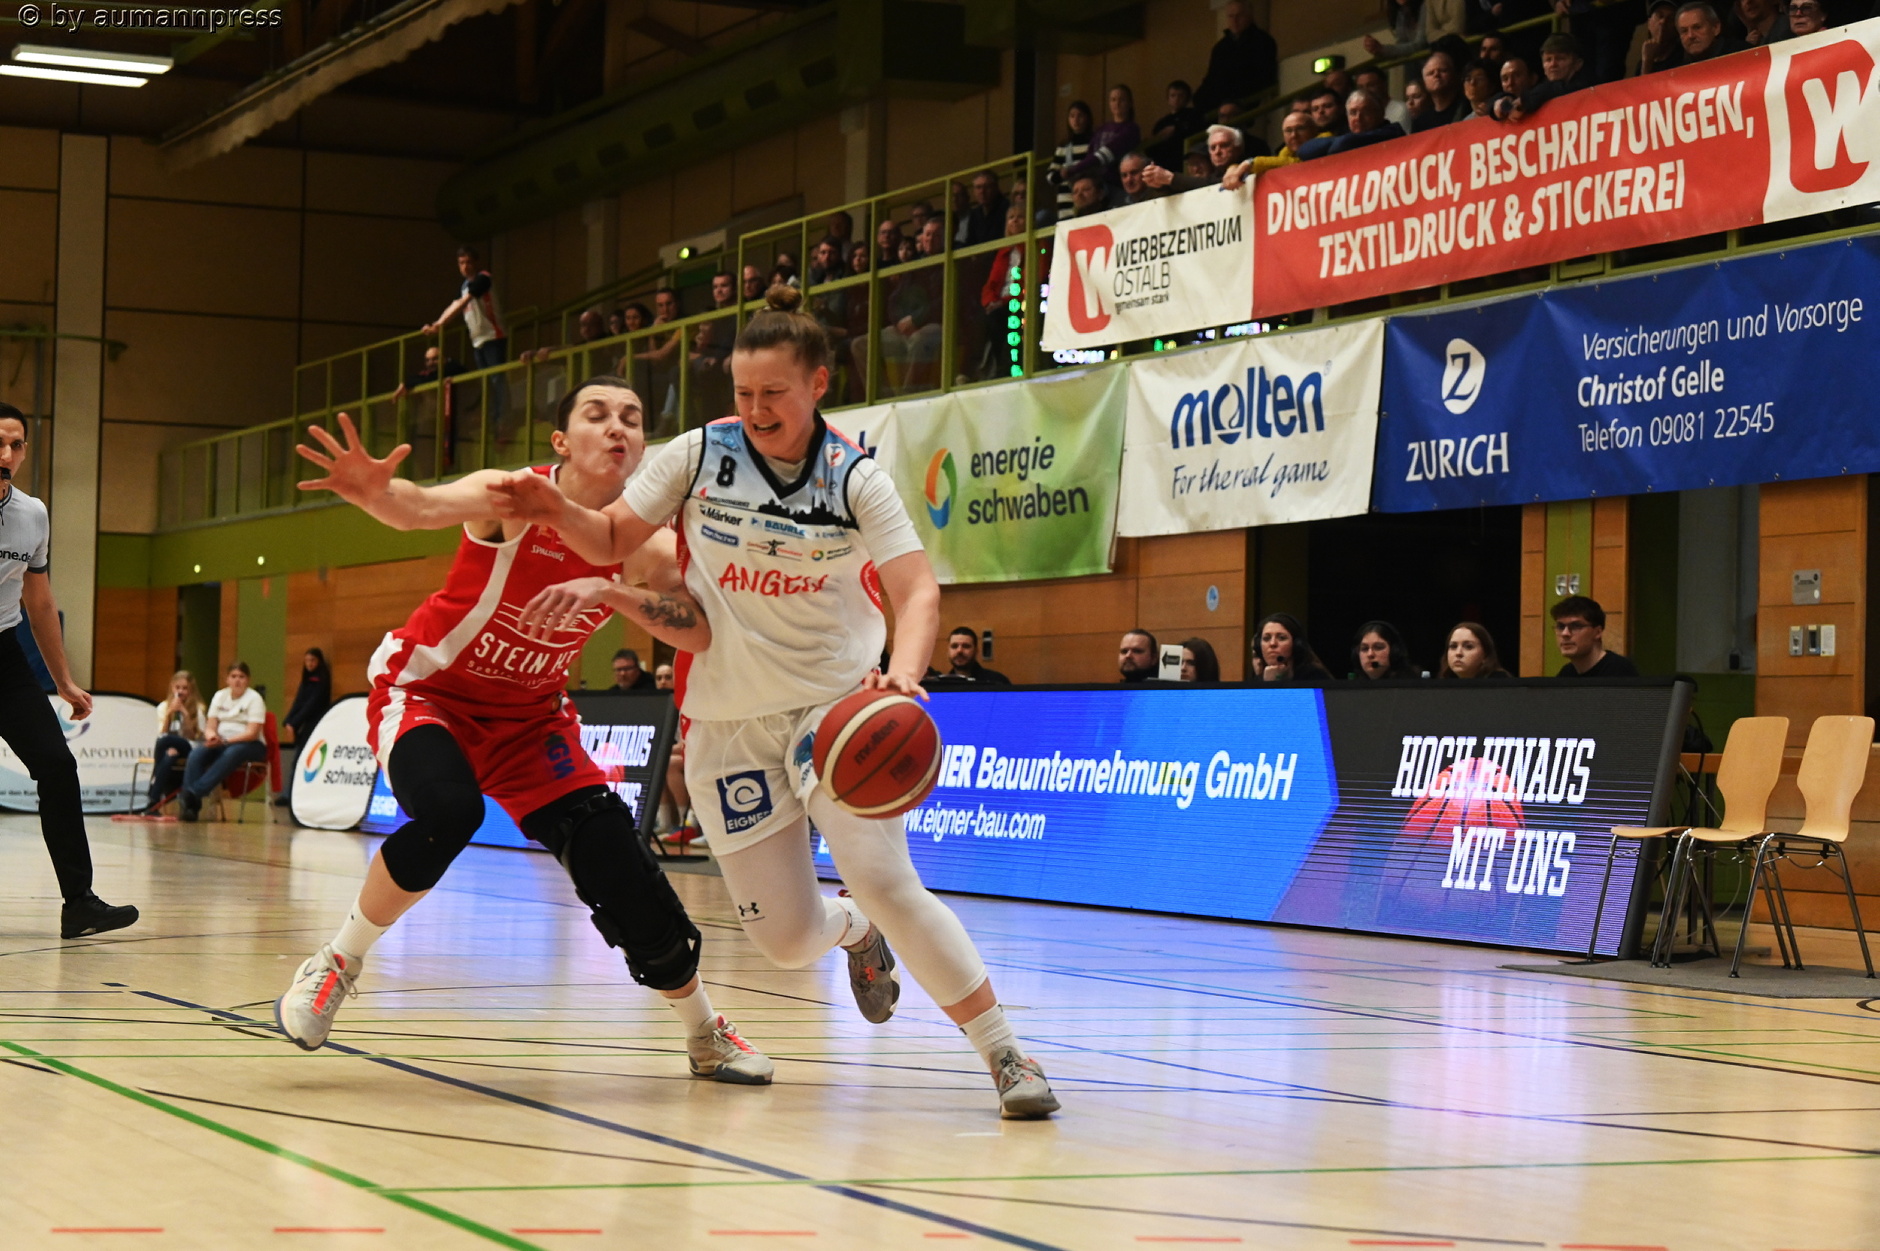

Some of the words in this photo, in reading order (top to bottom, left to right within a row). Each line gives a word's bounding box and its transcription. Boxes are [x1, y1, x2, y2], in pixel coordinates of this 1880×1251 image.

[1267, 148, 1461, 236] DIGITALDRUCK,
[1469, 80, 1754, 191] BESCHRIFTUNGEN,
[1115, 215, 1242, 268] WERBEZENTRUM
[1318, 198, 1496, 279] TEXTILDRUCK
[1502, 193, 1525, 242] &
[1528, 158, 1685, 236] STICKEREI
[1113, 261, 1171, 298] OSTALB
[1582, 319, 1719, 361] Versicherungen
[1727, 304, 1768, 341] und
[1775, 298, 1863, 333] Vorsorge
[1171, 366, 1325, 449] molten
[1577, 366, 1666, 407] Christof
[1671, 359, 1725, 398] Gelle
[1578, 418, 1643, 452] Telefon
[1650, 411, 1705, 447] 09081
[1714, 402, 1775, 438] 22545
[716, 455, 737, 489] 8
[970, 436, 1055, 481] energie
[1172, 464, 1196, 500] For
[1199, 459, 1231, 493] the
[1271, 460, 1331, 499] game
[1405, 431, 1510, 482] ZURICH
[967, 482, 1090, 525] schwaben
[530, 544, 566, 563] SPALDING
[474, 632, 551, 675] STEIN
[975, 747, 1200, 810] Bauunternehmung
[1204, 749, 1298, 801] GmbH
[1391, 736, 1478, 800] HOCH
[1472, 737, 1596, 805] HINAUS
[1441, 825, 1507, 892] MIT
[1505, 829, 1577, 897] UNS
